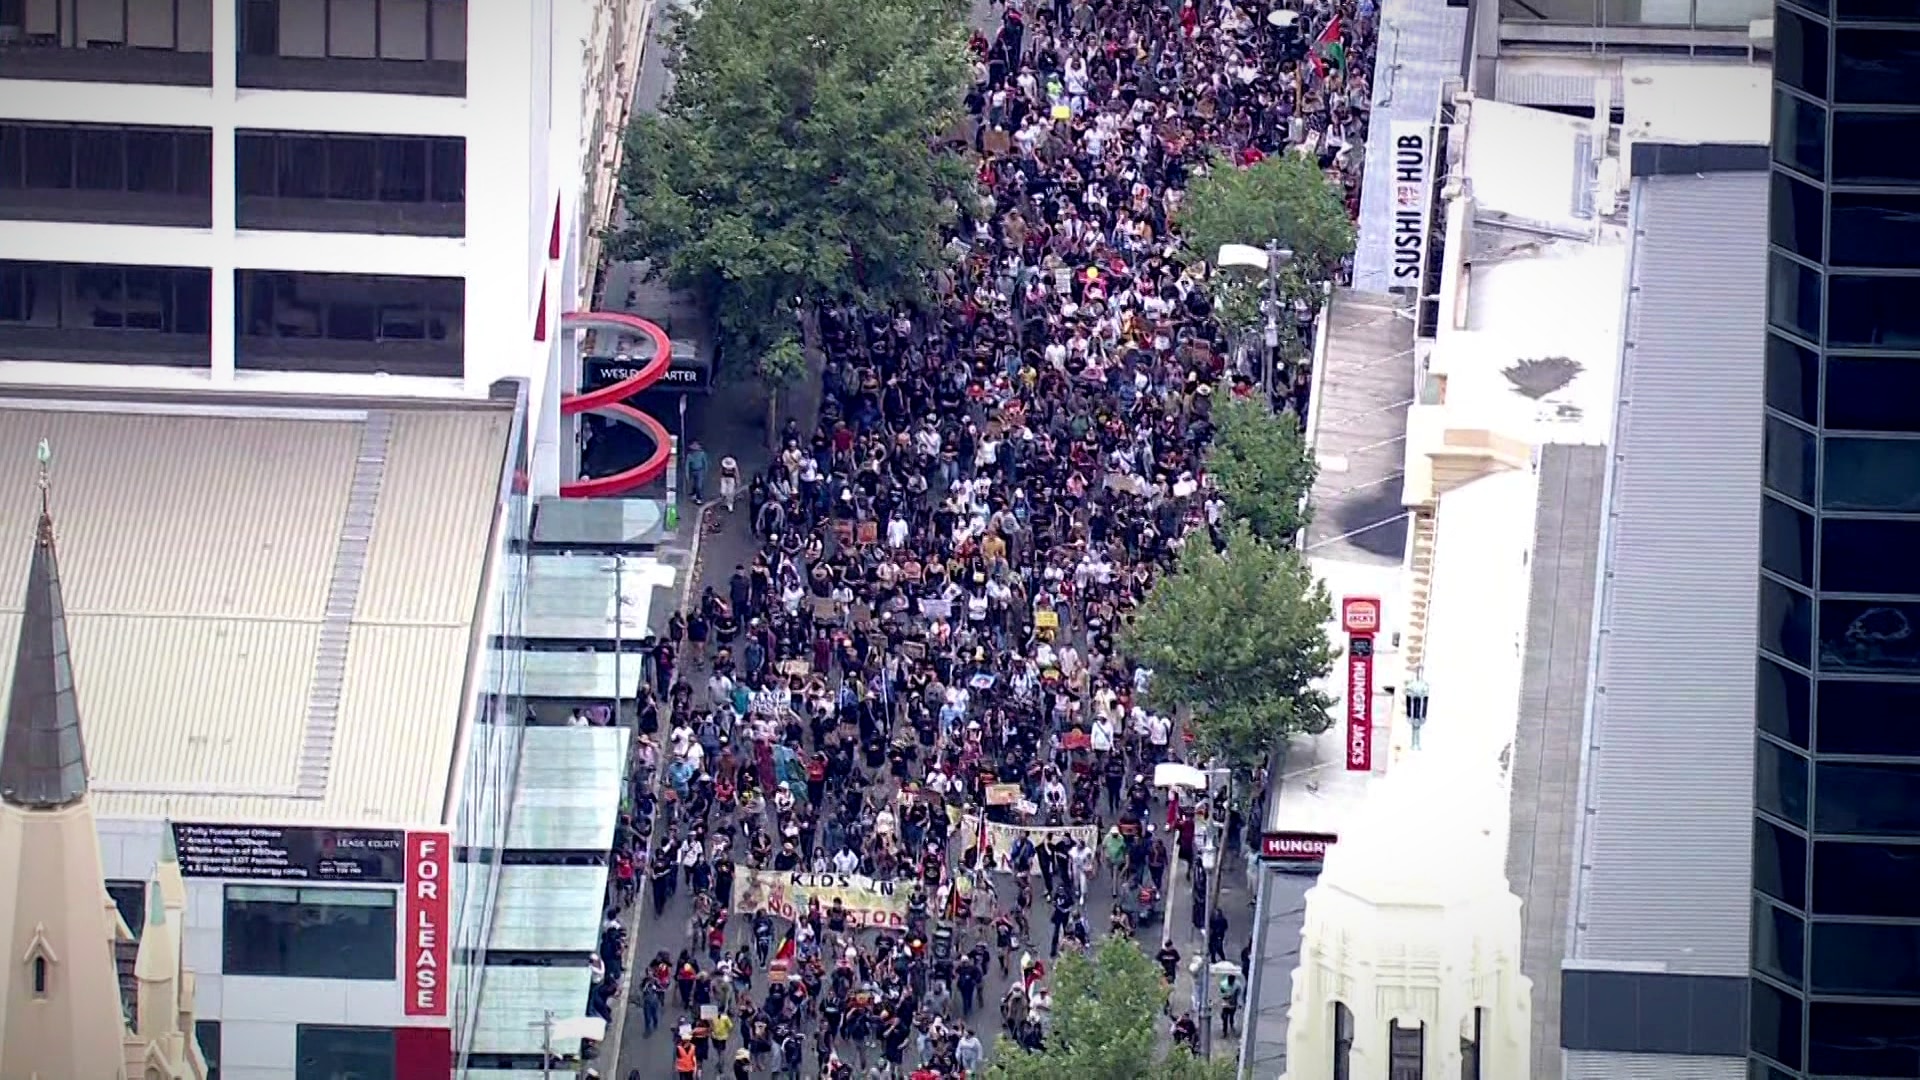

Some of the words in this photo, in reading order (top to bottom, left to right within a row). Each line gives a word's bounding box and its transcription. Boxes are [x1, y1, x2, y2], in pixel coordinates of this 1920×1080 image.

[1397, 135, 1423, 182] HUB
[1394, 212, 1422, 279] SUSHI
[600, 368, 639, 379] WESLE
[1352, 661, 1366, 721] HUNGRY
[417, 840, 438, 899] FOR
[790, 873, 851, 888] KIDS
[864, 878, 894, 896] IN
[416, 910, 437, 1008] LEASE
